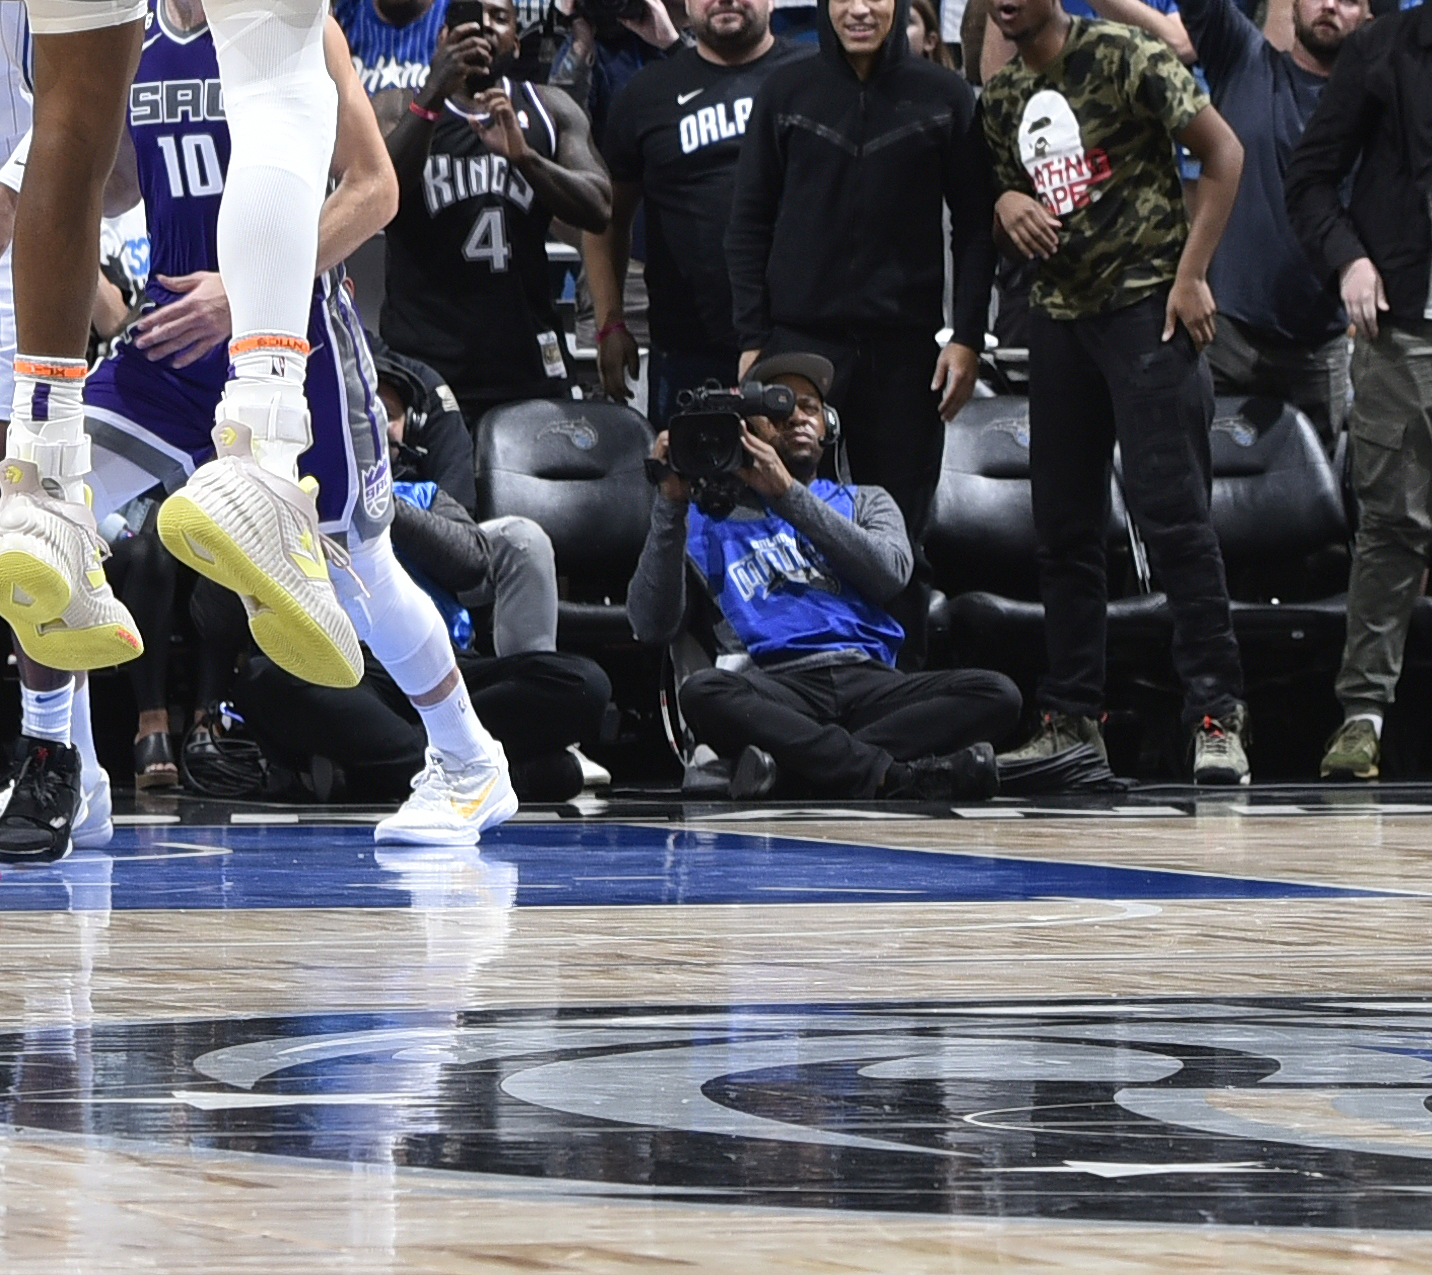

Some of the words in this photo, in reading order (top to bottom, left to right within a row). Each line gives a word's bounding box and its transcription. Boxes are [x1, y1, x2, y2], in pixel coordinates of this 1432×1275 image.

[678, 97, 754, 155] ORLA
[157, 133, 224, 198] 10
[422, 152, 533, 217] KINGS
[461, 206, 512, 273] 4
